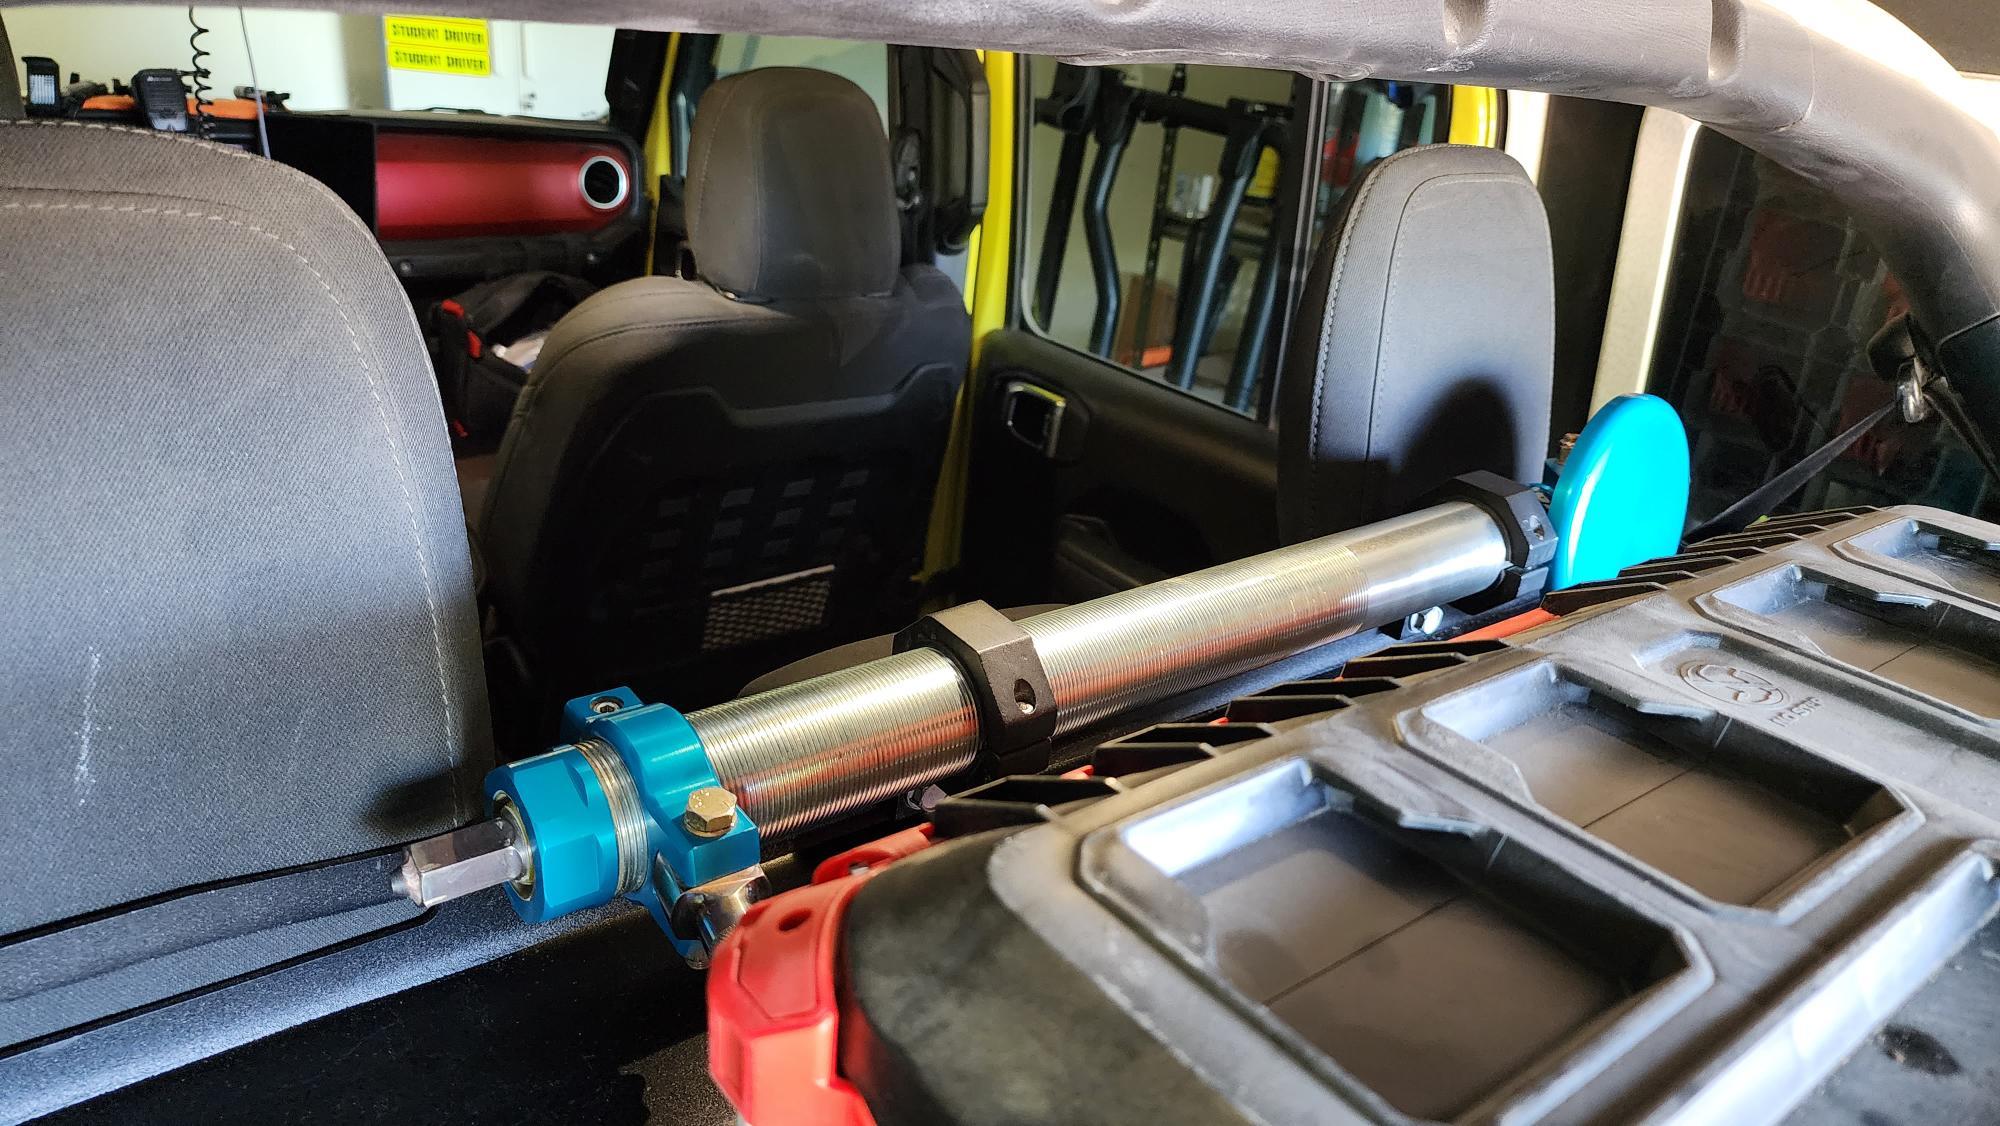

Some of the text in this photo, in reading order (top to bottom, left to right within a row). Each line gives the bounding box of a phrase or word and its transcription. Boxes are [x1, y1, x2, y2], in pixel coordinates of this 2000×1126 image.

[392, 24, 485, 45] STUDENT DRIVER
[394, 50, 487, 71] STUDENT DRIVER
